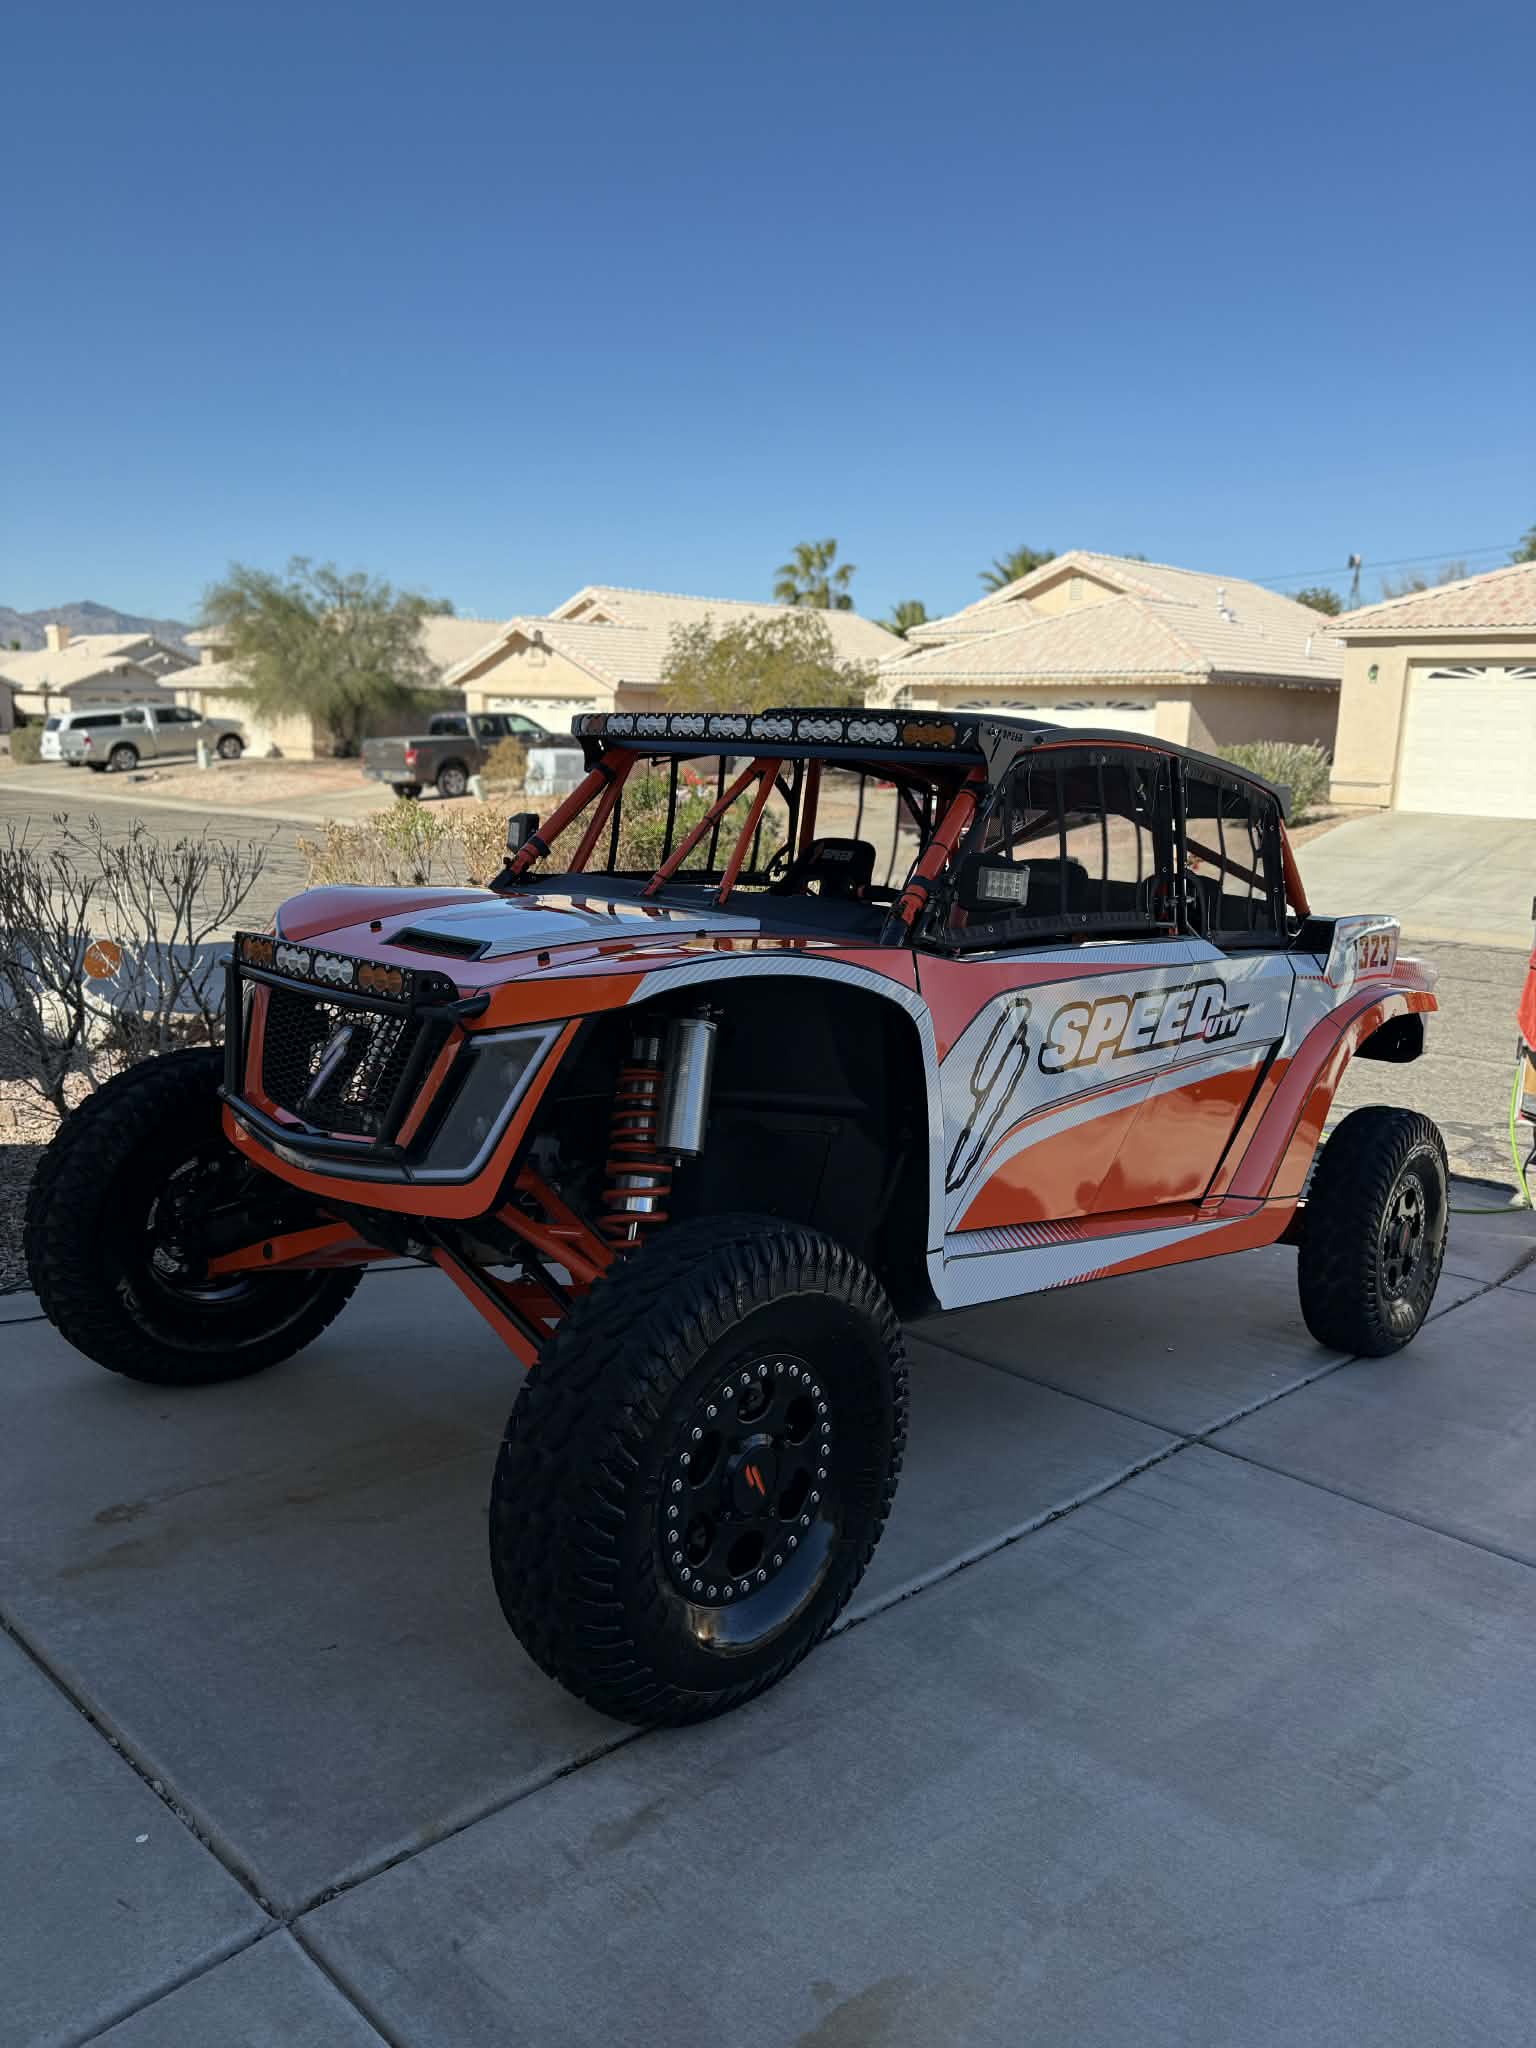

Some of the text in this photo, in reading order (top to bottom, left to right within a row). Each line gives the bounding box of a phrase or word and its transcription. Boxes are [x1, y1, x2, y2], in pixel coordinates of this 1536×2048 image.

[1359, 935, 1390, 969] 323
[1039, 978, 1248, 1073] SPEED UTV
